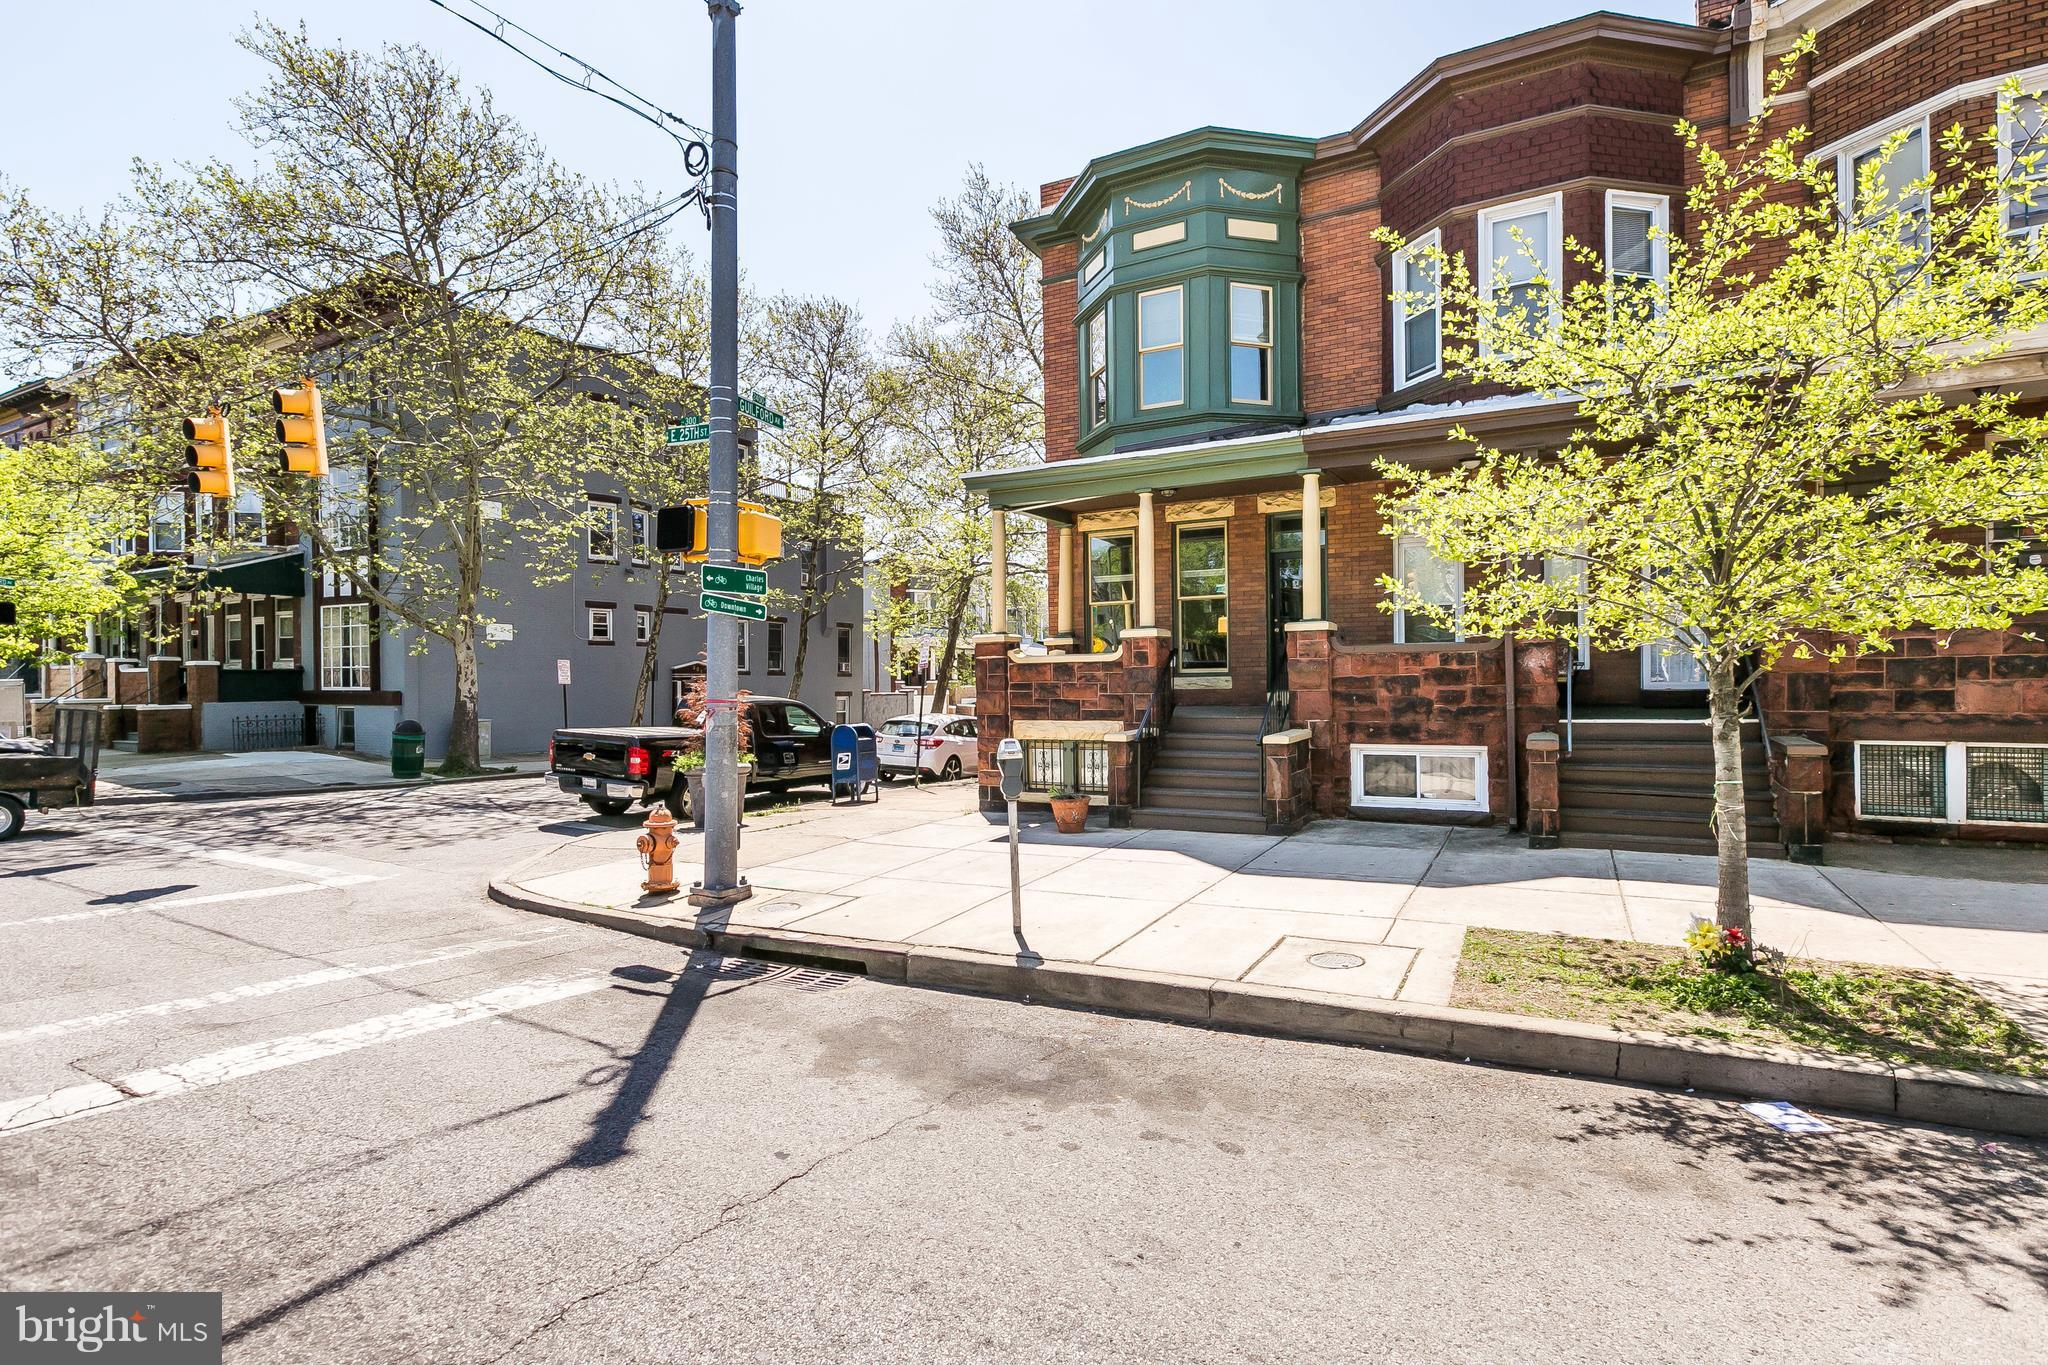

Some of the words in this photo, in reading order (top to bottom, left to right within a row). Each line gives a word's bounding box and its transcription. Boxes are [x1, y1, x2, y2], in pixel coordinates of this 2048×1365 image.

[739, 399, 774, 424] GUILFORD
[684, 416, 697, 425] 300
[679, 427, 700, 441] 25TH
[745, 574, 764, 583] Charles
[745, 583, 763, 592] Village
[720, 601, 747, 613] Downtown
